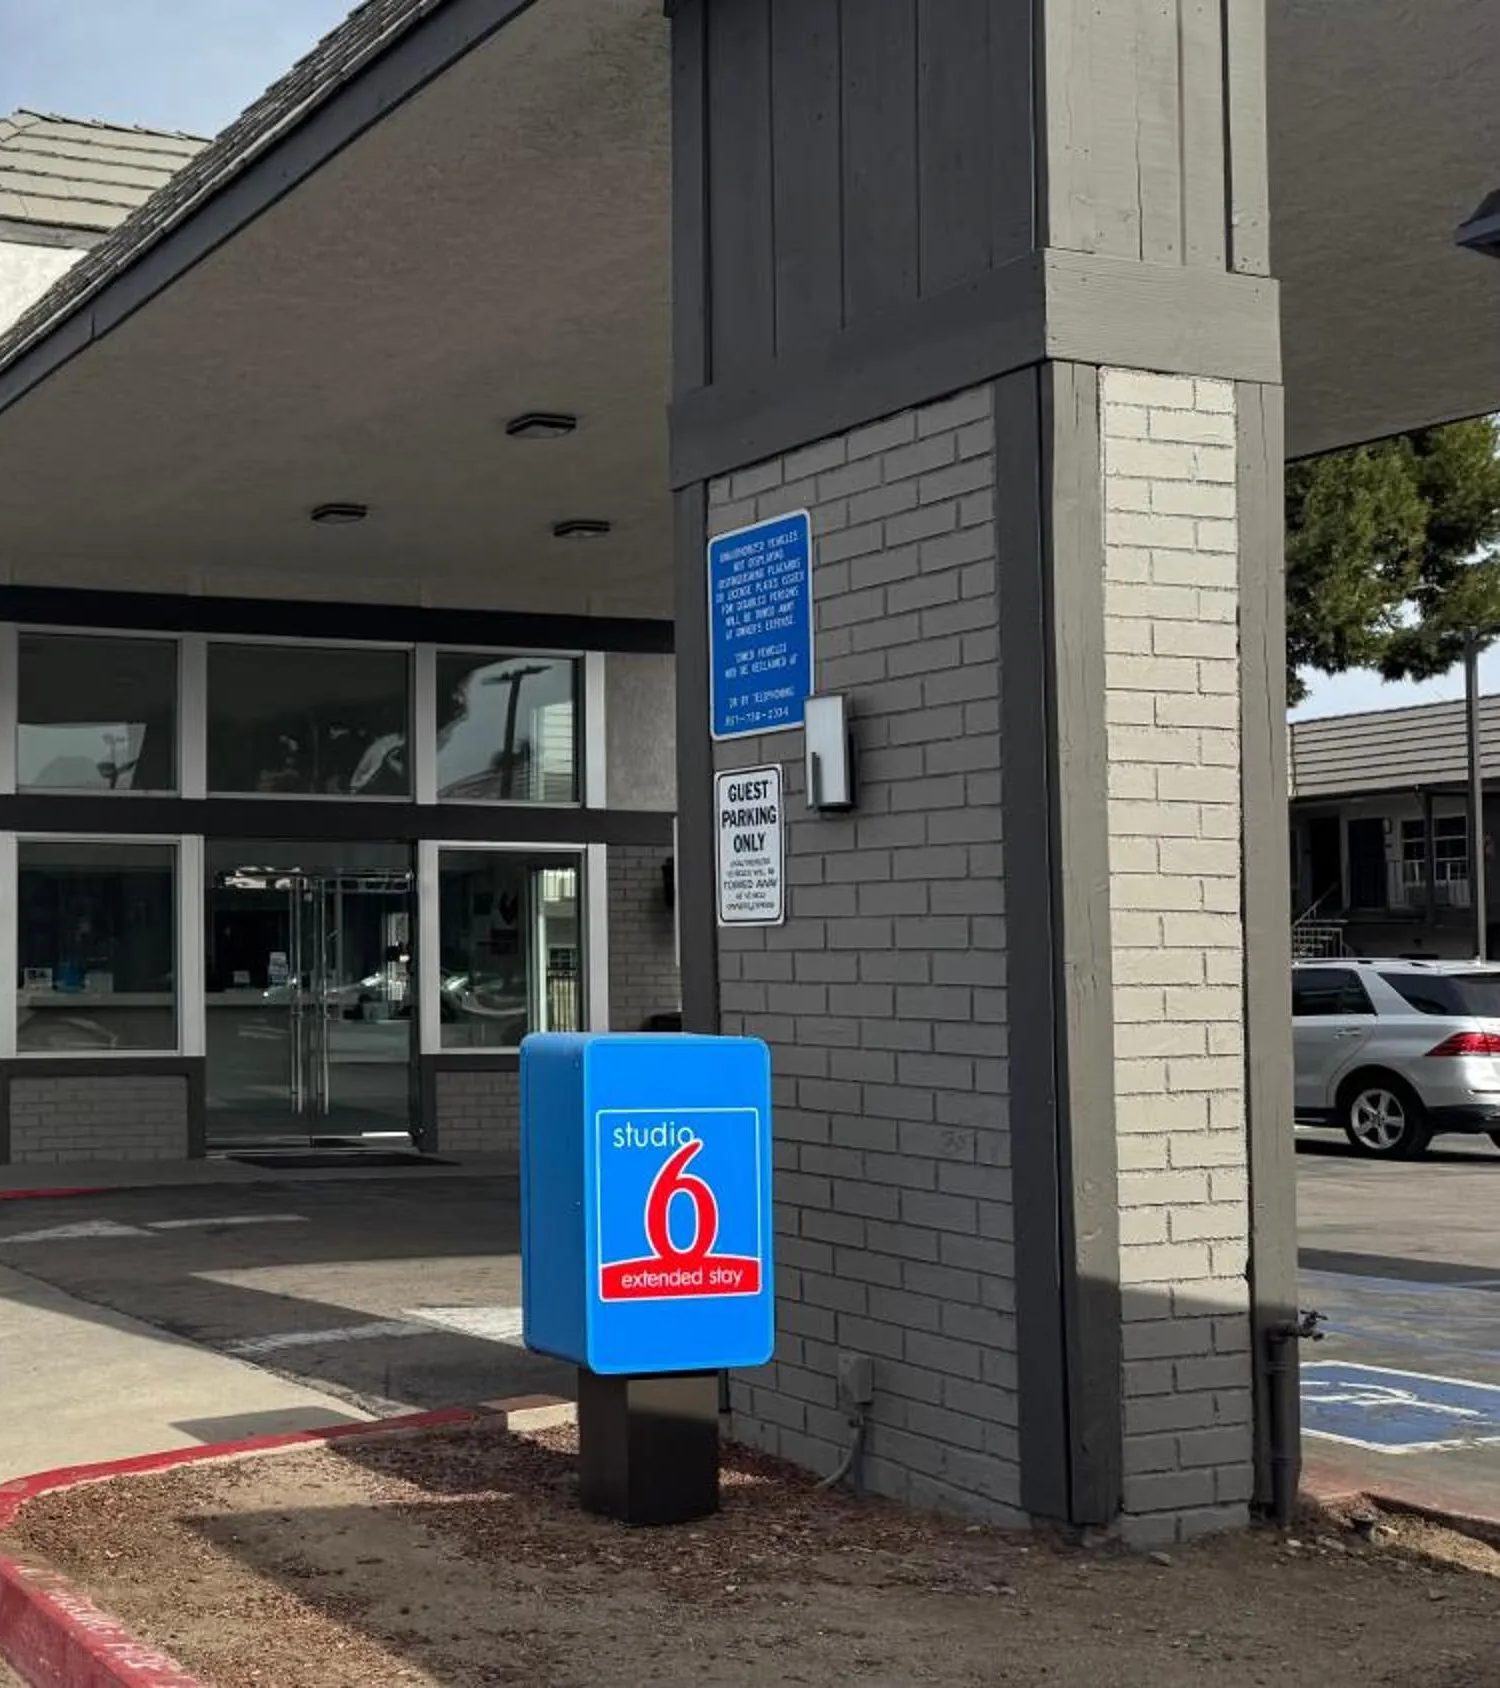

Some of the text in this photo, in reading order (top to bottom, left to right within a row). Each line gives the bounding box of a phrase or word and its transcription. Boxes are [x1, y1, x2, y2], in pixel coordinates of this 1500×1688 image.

[728, 780, 769, 803] GUEST
[722, 805, 777, 829] PARKING
[733, 832, 766, 853] ONLY
[612, 1122, 695, 1148] studio
[644, 1138, 719, 1257] 6
[621, 1268, 744, 1289] extended stay
